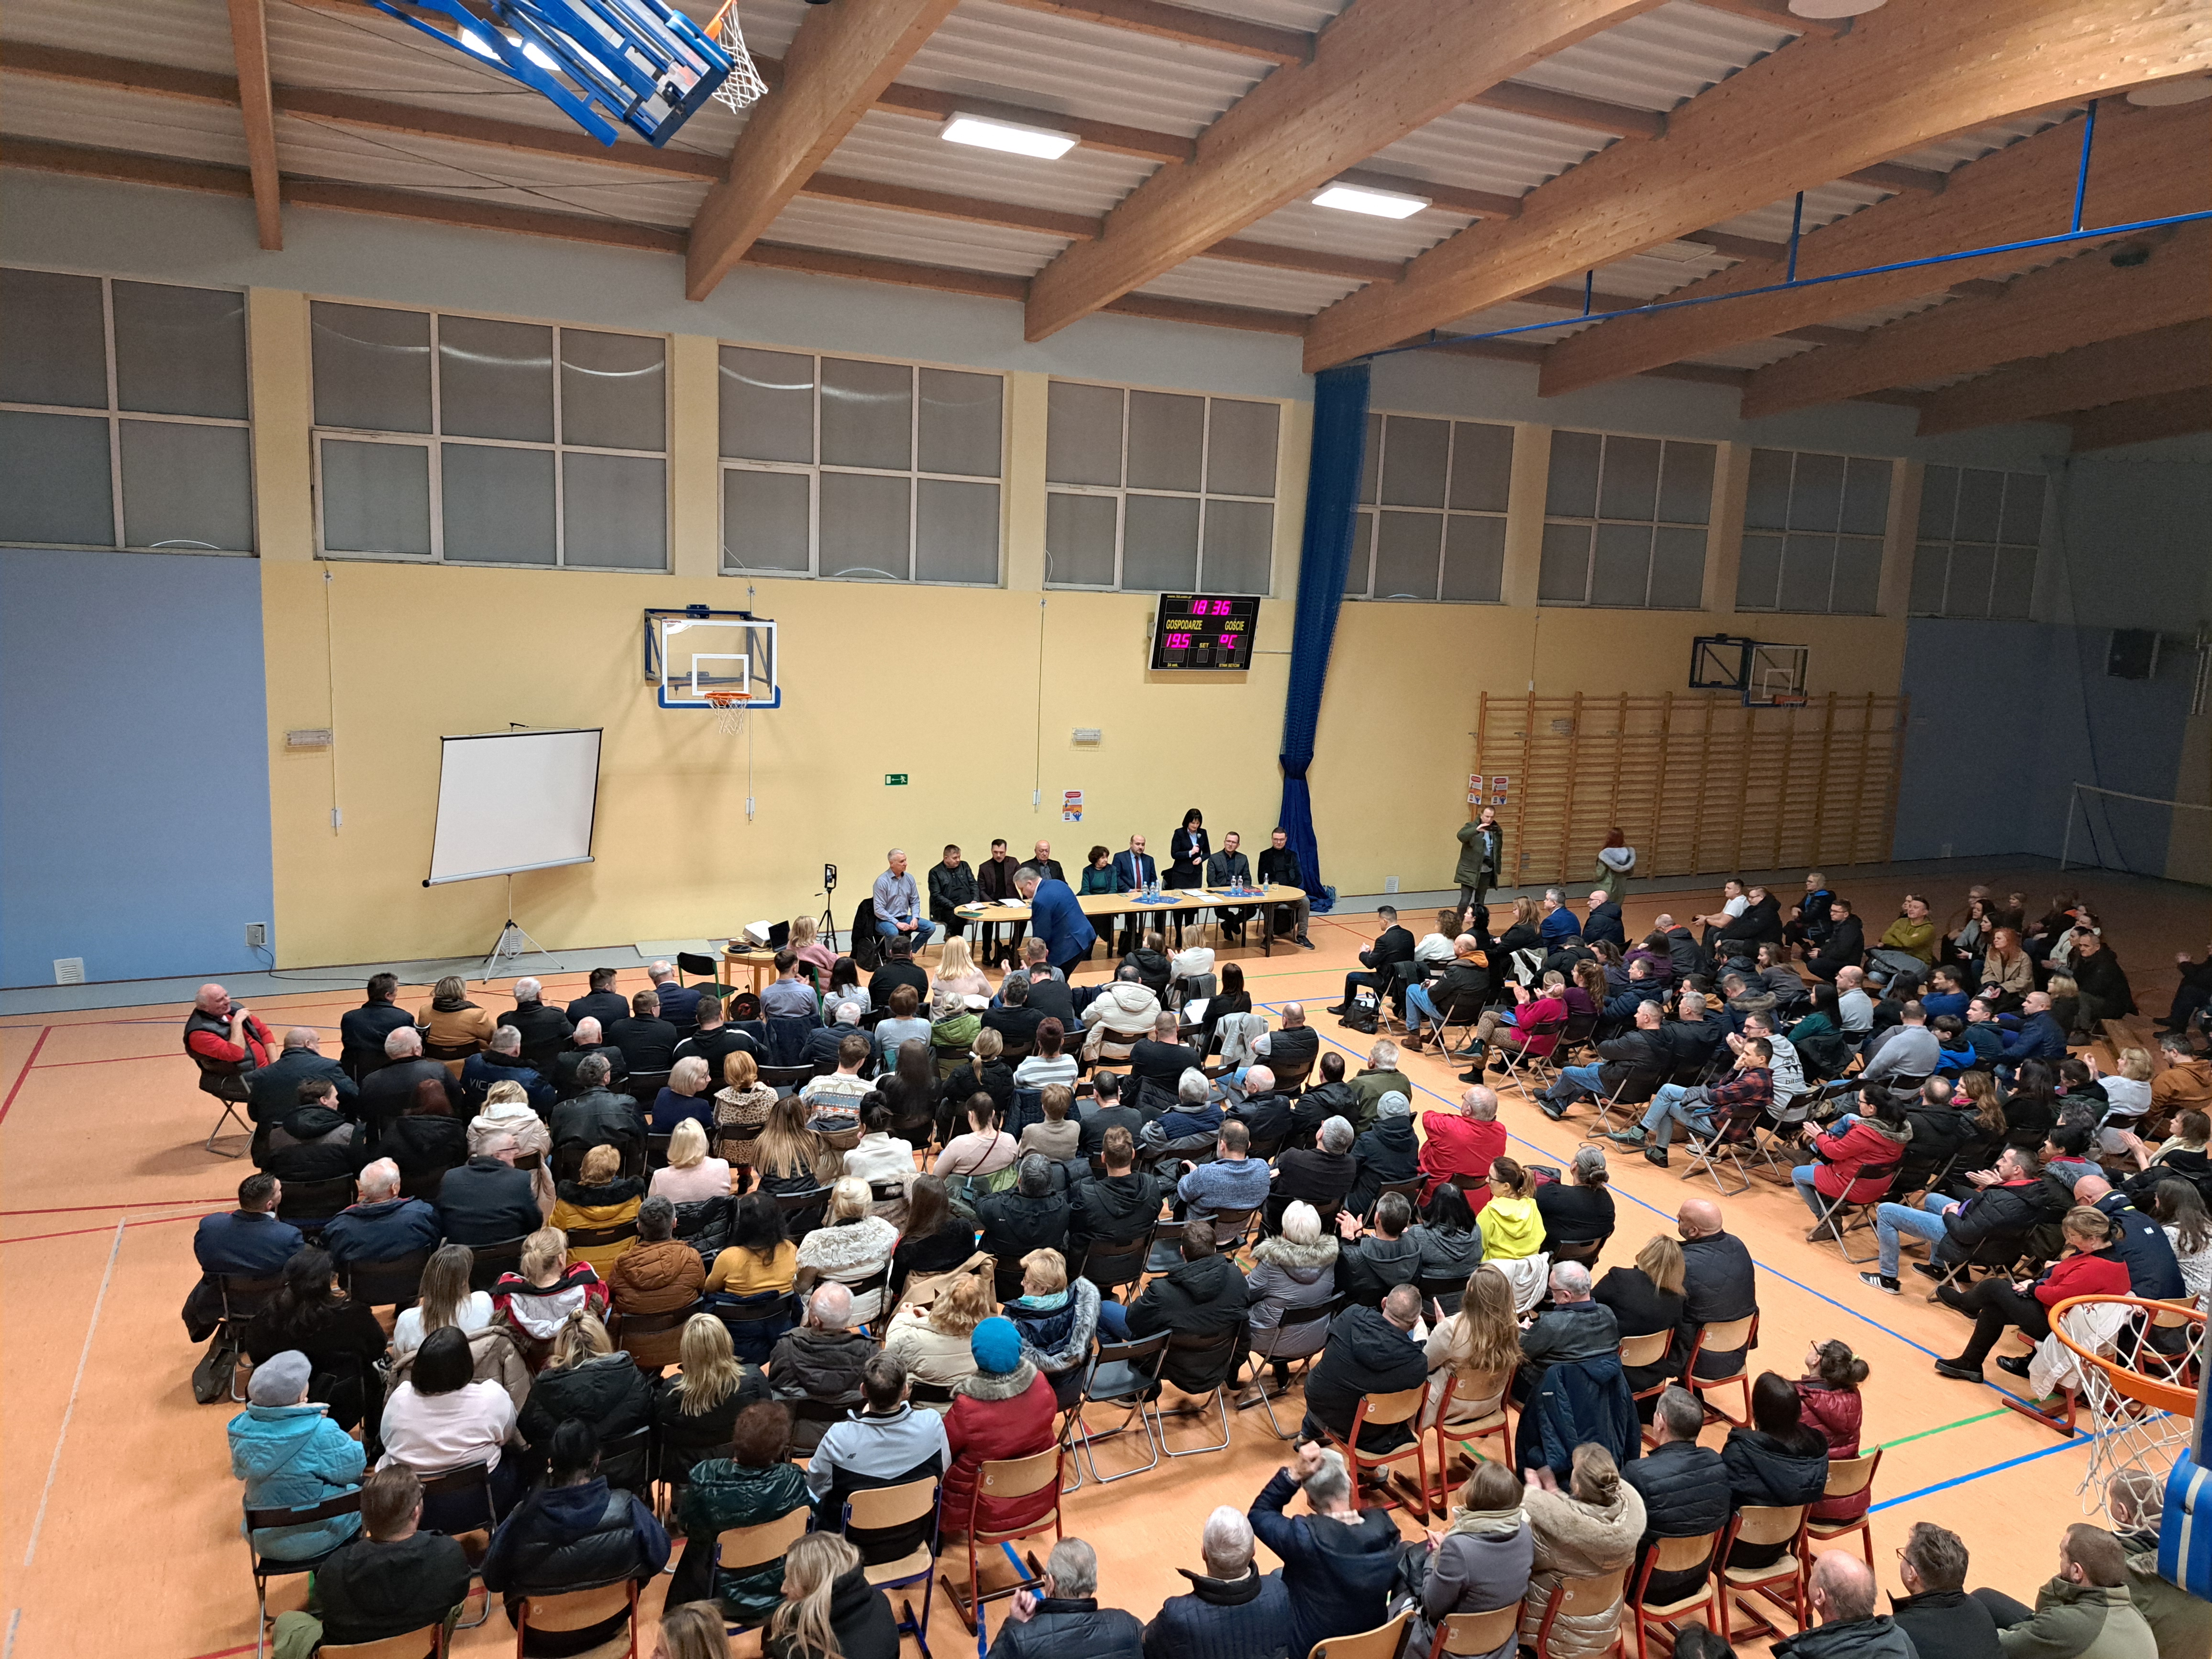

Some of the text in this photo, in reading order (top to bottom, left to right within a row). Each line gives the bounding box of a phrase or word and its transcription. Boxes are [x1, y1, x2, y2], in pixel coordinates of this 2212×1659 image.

[1166, 618, 1245, 631] GOSPODARZE GOŚCIE
[1622, 1349, 1629, 1357] 6
[1368, 1403, 1376, 1412] 6
[986, 1475, 994, 1485] 6
[1565, 1590, 1574, 1600] 6
